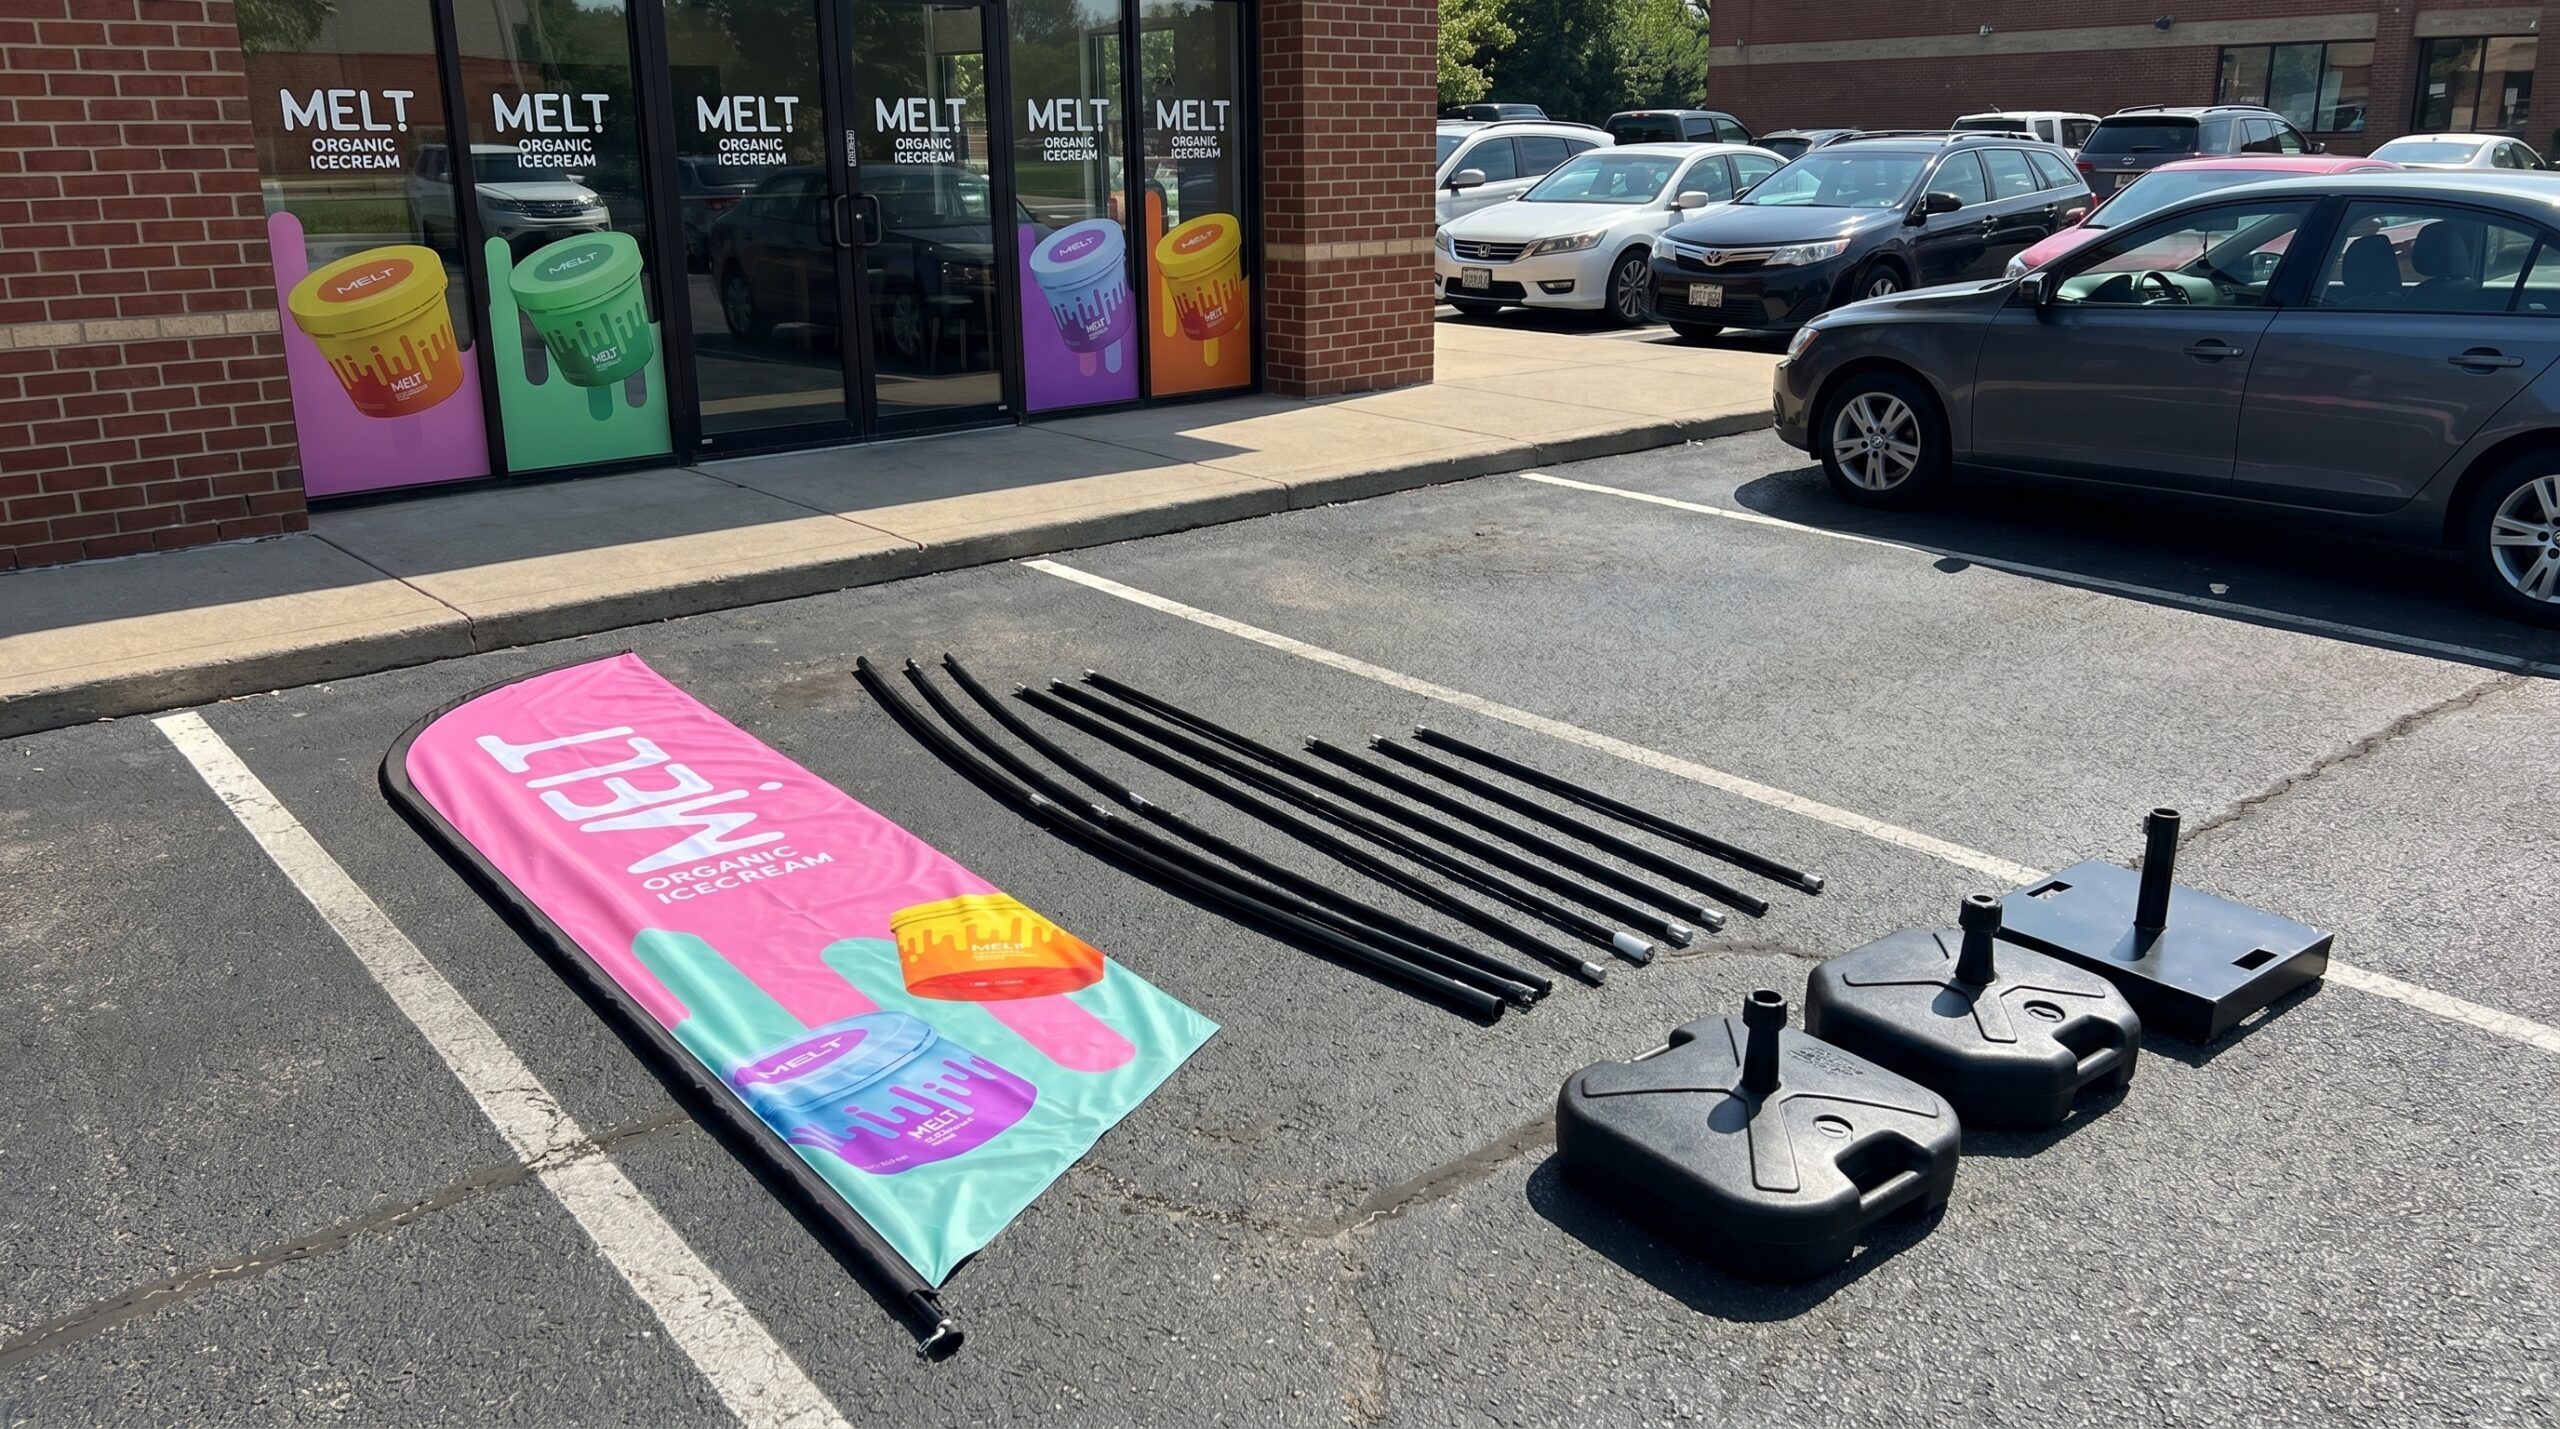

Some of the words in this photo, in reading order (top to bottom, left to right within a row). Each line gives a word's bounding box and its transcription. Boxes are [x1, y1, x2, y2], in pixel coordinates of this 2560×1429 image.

[279, 88, 415, 132] MELT
[492, 93, 610, 133] MELT
[696, 95, 799, 133] MELT
[875, 97, 967, 133] MELT
[1027, 98, 1110, 132] MELT
[1156, 99, 1231, 132] MELT
[311, 138, 396, 153] ORGANIC
[518, 139, 593, 153] ORGANIC
[719, 138, 784, 151] ORGANIC
[895, 138, 952, 150] ORGANIC
[1044, 137, 1095, 149] ORGANIC
[1171, 136, 1218, 147] ORGANIC
[310, 154, 400, 170] ICECREAM
[517, 154, 597, 169] ICECREAM
[718, 153, 787, 166] ICECREAM
[894, 152, 955, 164] ICECREAM
[1043, 150, 1098, 161] ICECREAM
[1171, 148, 1221, 159] ICECREAM
[548, 251, 598, 274] MELT
[336, 267, 394, 294] MELT
[390, 372, 422, 392] MELT
[475, 726, 786, 874] MELT
[642, 845, 799, 891] ORGANIC
[656, 851, 835, 905] ICECREAM
[757, 1036, 843, 1079] MELT
[907, 1109, 959, 1139] MELT
